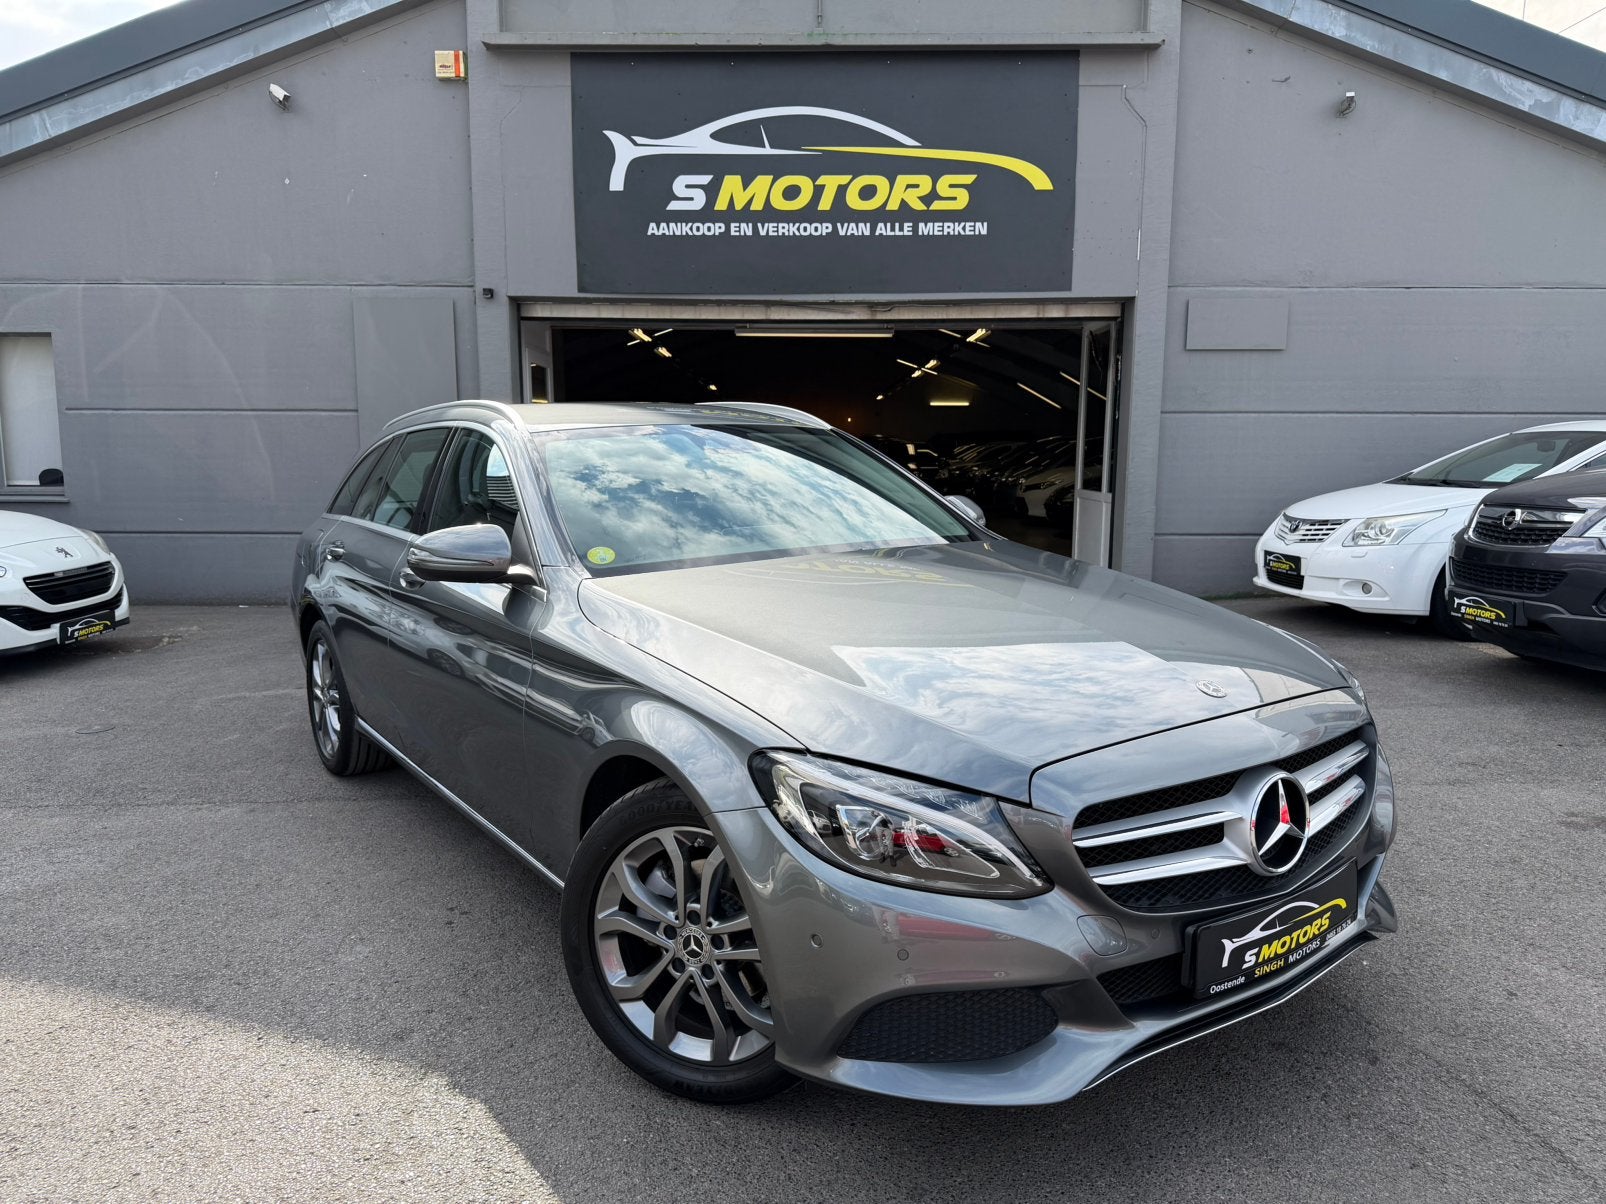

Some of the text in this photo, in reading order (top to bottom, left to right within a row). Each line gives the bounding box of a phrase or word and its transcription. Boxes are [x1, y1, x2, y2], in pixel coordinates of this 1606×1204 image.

[714, 175, 978, 210] MOTORS
[647, 221, 988, 236] AANKOOP EN VERKOOP VAN ALLE MERKEN
[1465, 607, 1497, 620] MOTORS
[1258, 911, 1331, 963] MOTORS
[1209, 938, 1321, 994] Oostende SINGH MOTORS
